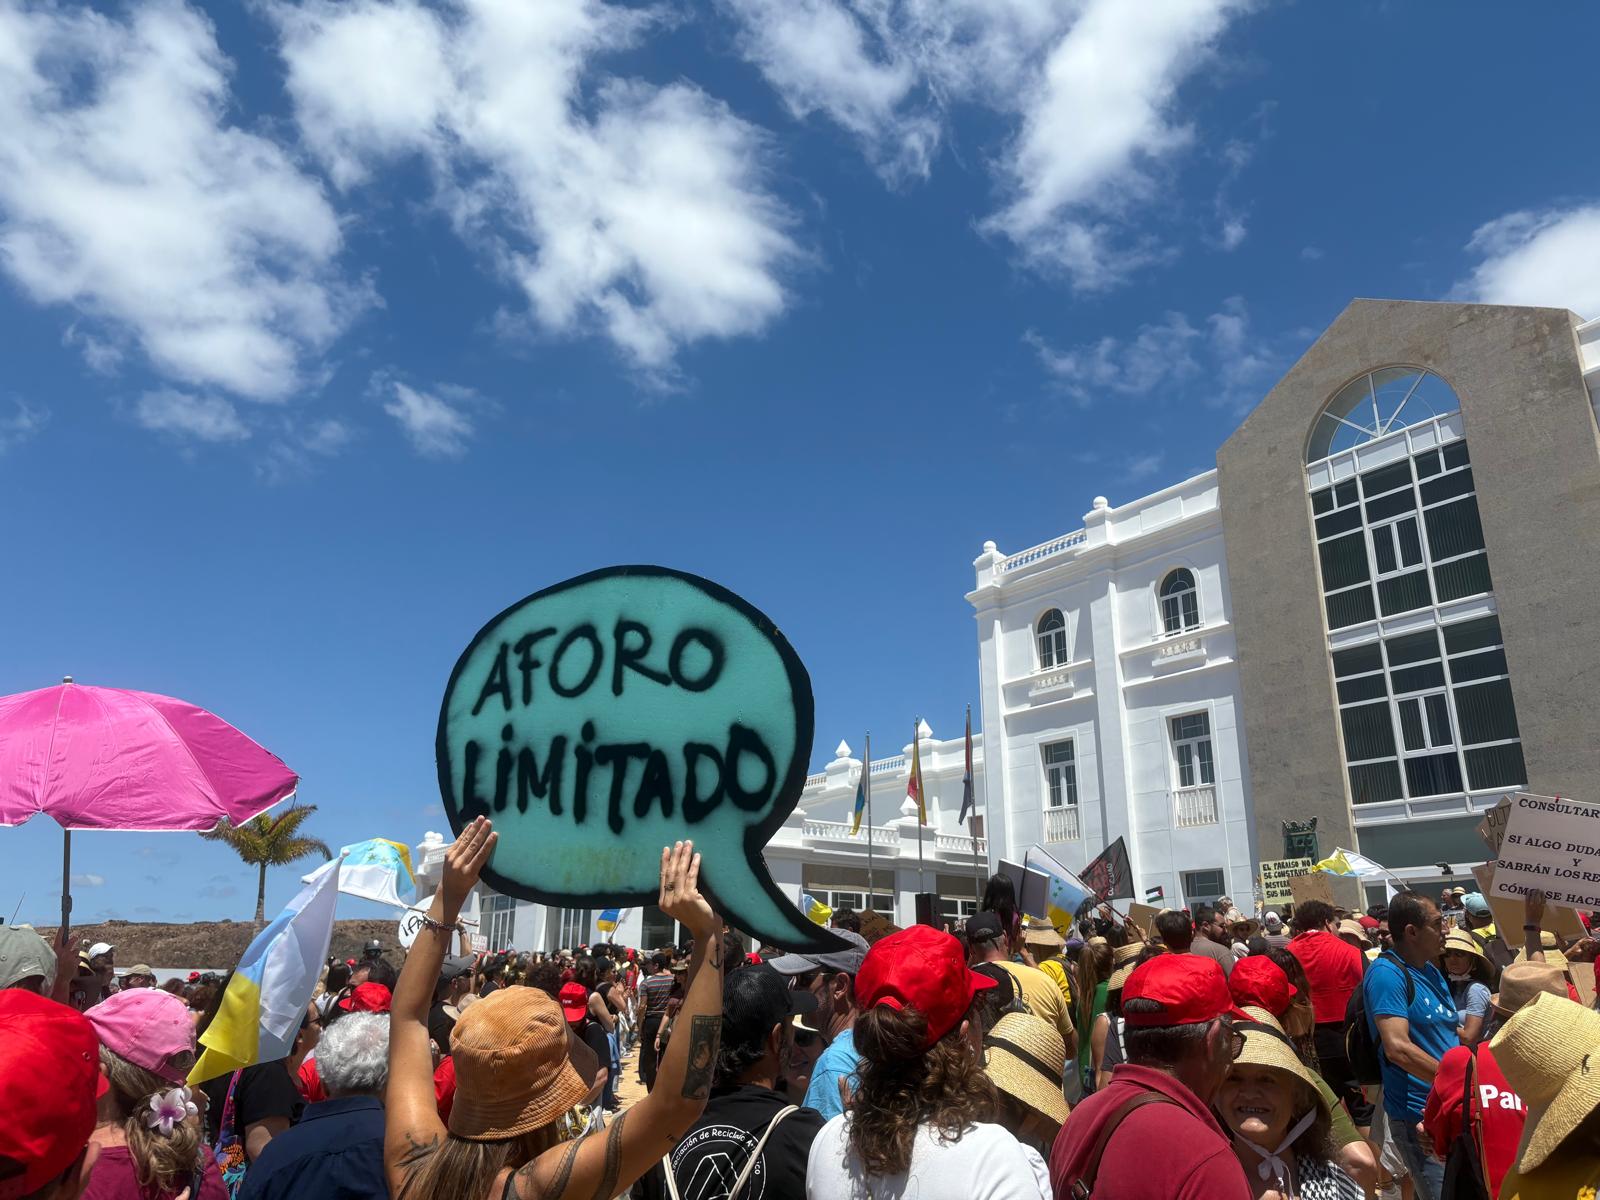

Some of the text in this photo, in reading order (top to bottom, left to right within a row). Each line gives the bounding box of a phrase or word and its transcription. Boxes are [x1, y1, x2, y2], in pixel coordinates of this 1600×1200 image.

[472, 617, 724, 716] AFORO
[1508, 835, 1522, 844] SI
[1525, 838, 1561, 849] ALGO
[1497, 860, 1551, 874] SABRÁN
[1554, 868, 1581, 879] LOS
[1573, 858, 1582, 867] Y
[1545, 891, 1562, 900] SE
[1566, 894, 1600, 907] HACE
[699, 1131, 710, 1140] de
